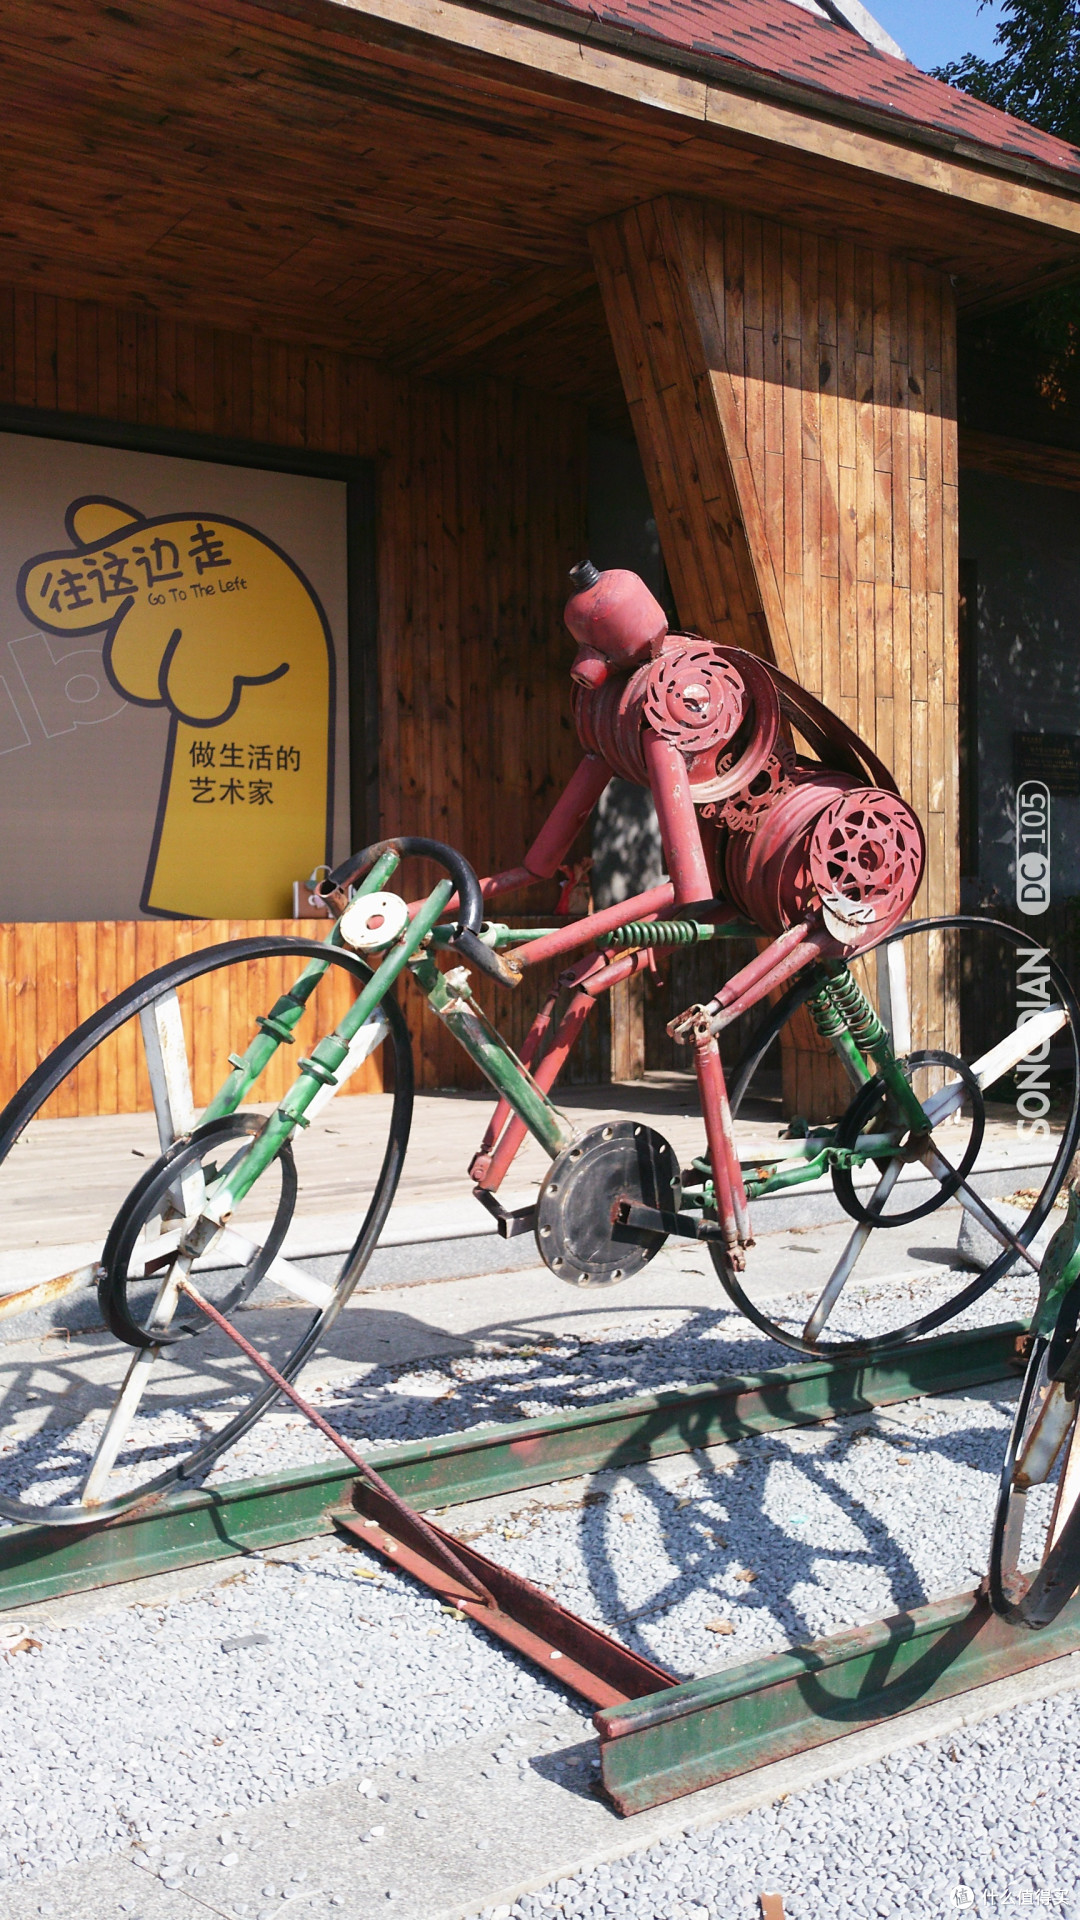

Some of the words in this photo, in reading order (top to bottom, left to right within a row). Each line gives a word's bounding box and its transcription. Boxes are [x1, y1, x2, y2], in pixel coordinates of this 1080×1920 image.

[41, 523, 231, 612] 往这边走
[148, 592, 166, 606] Go
[168, 588, 187, 602] To
[189, 583, 216, 598] The
[218, 576, 248, 593] Left
[189, 740, 300, 773] 做生活的
[189, 776, 274, 806] 艺术家
